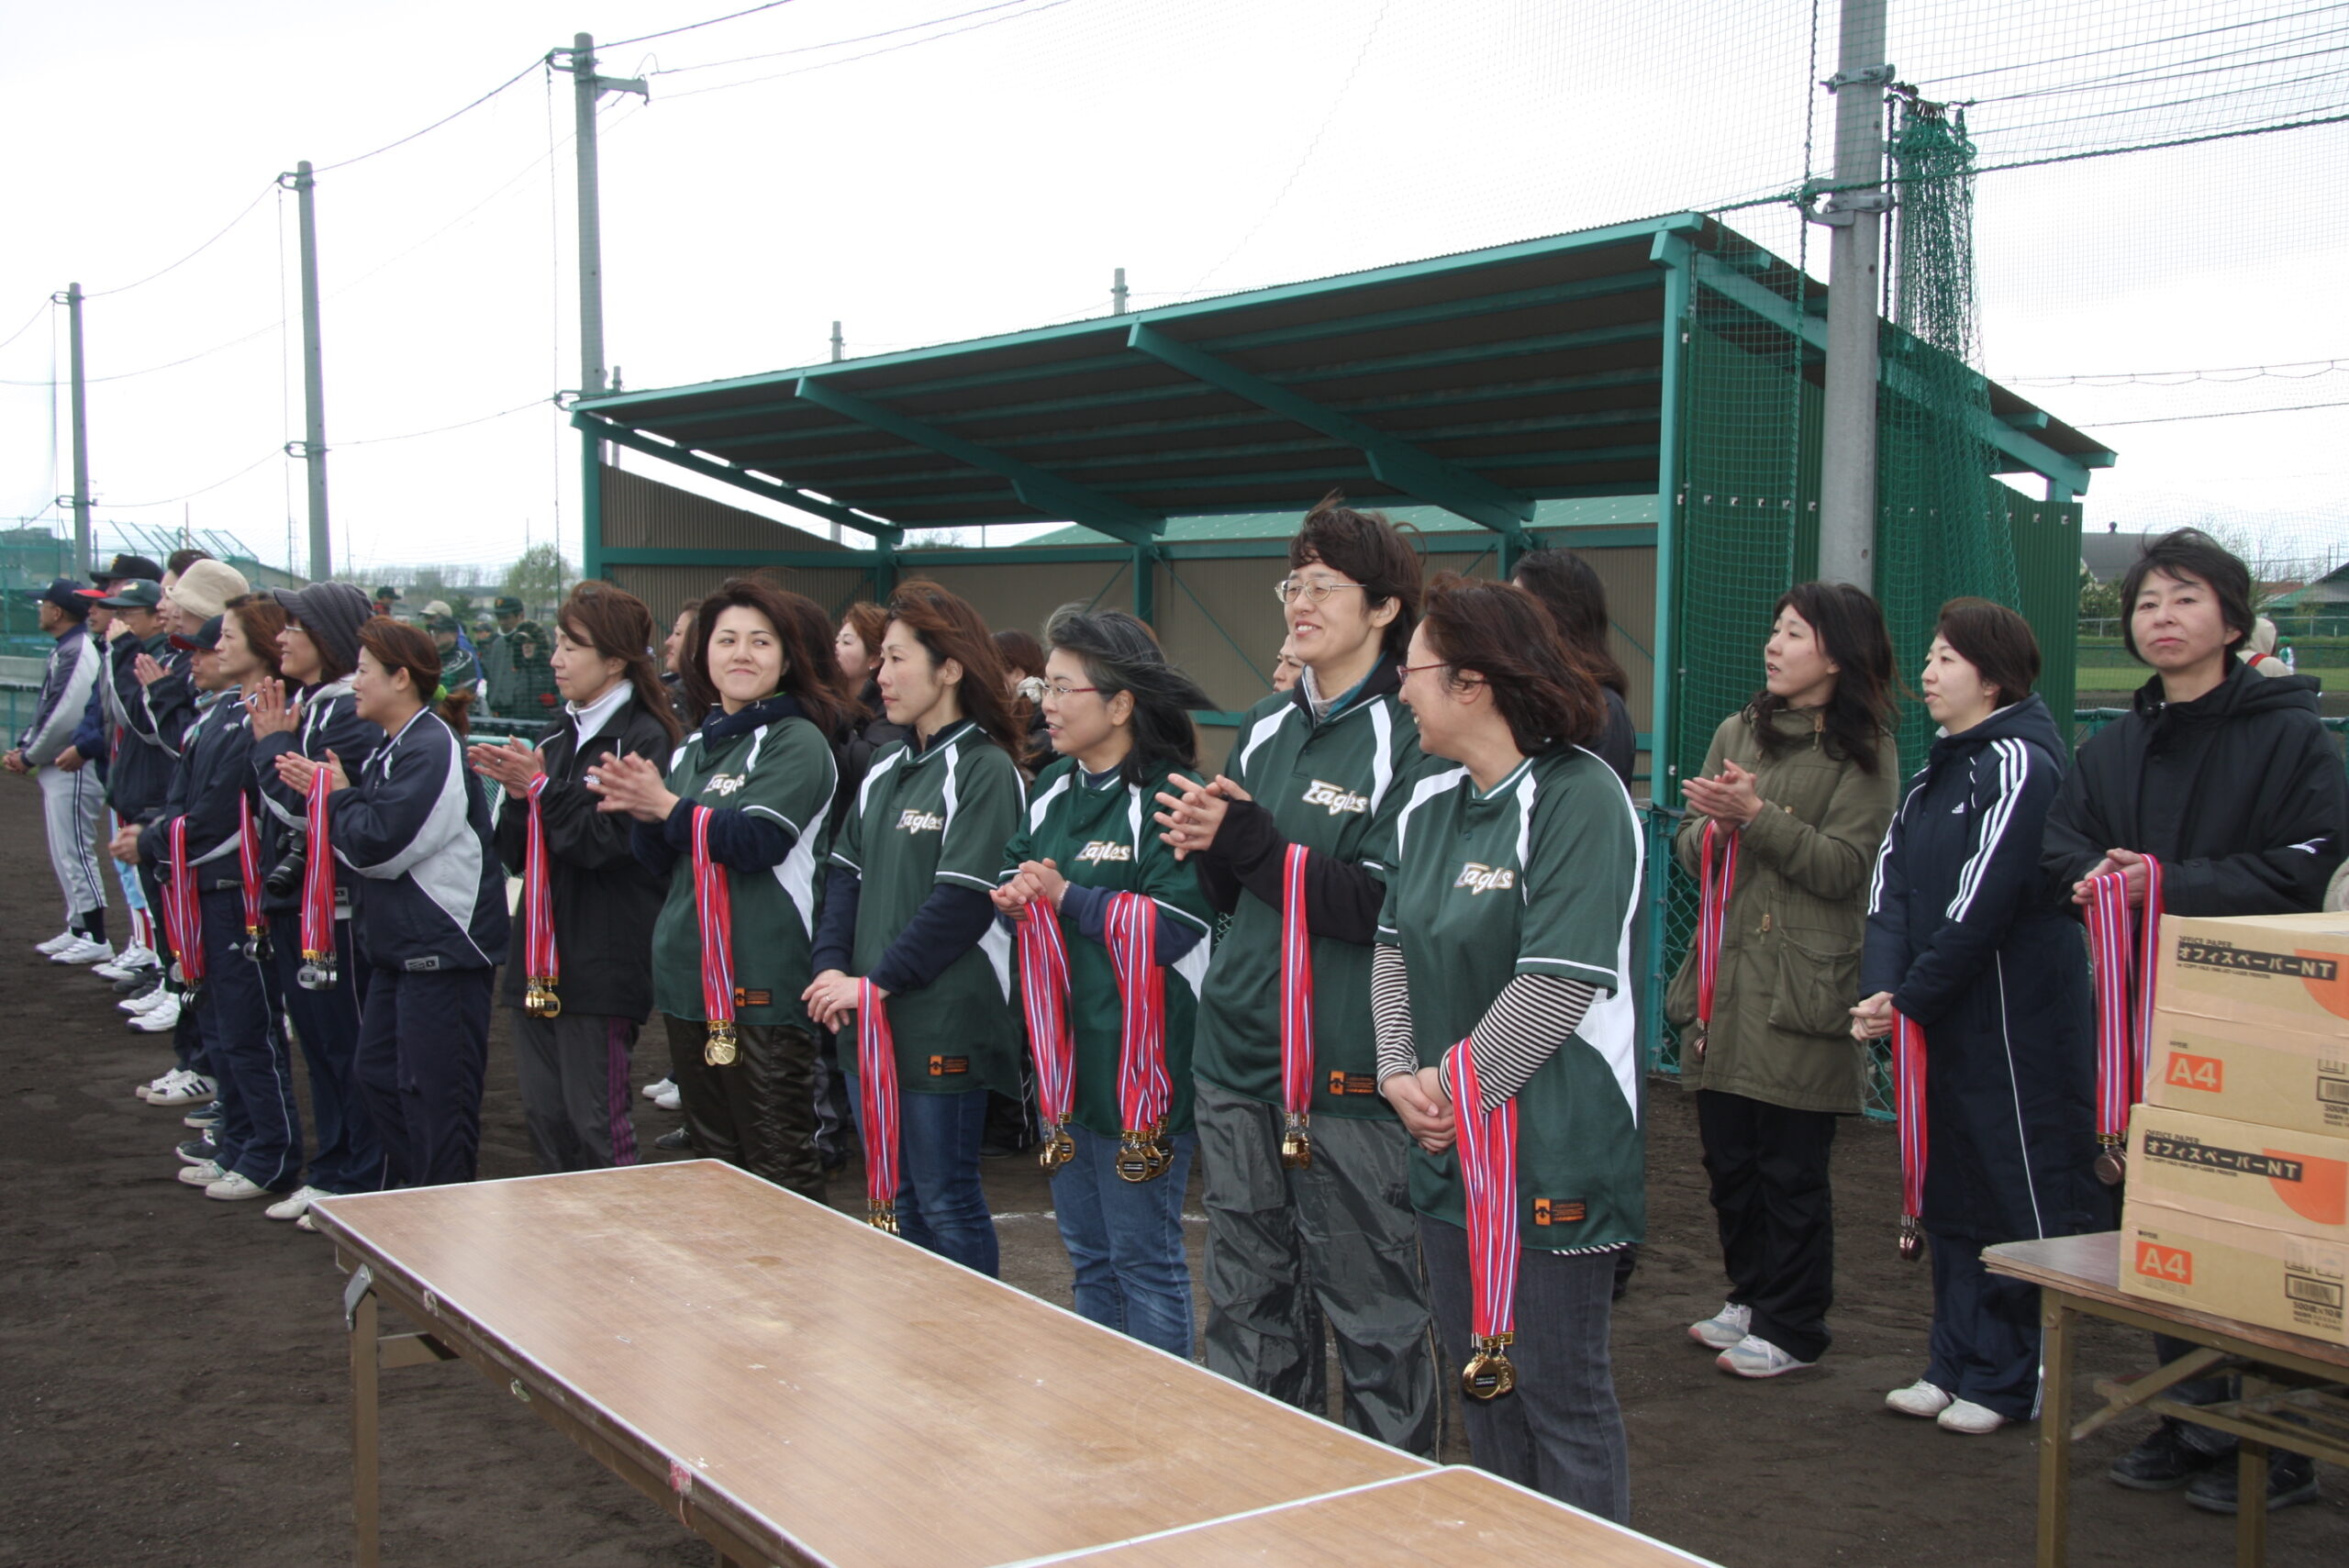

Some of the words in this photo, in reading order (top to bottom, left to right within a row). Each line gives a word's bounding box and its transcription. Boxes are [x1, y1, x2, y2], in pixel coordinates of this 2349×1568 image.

[896, 809, 943, 835] Eagles
[2170, 1058, 2218, 1088] A4
[2142, 1247, 2188, 1279] A4
